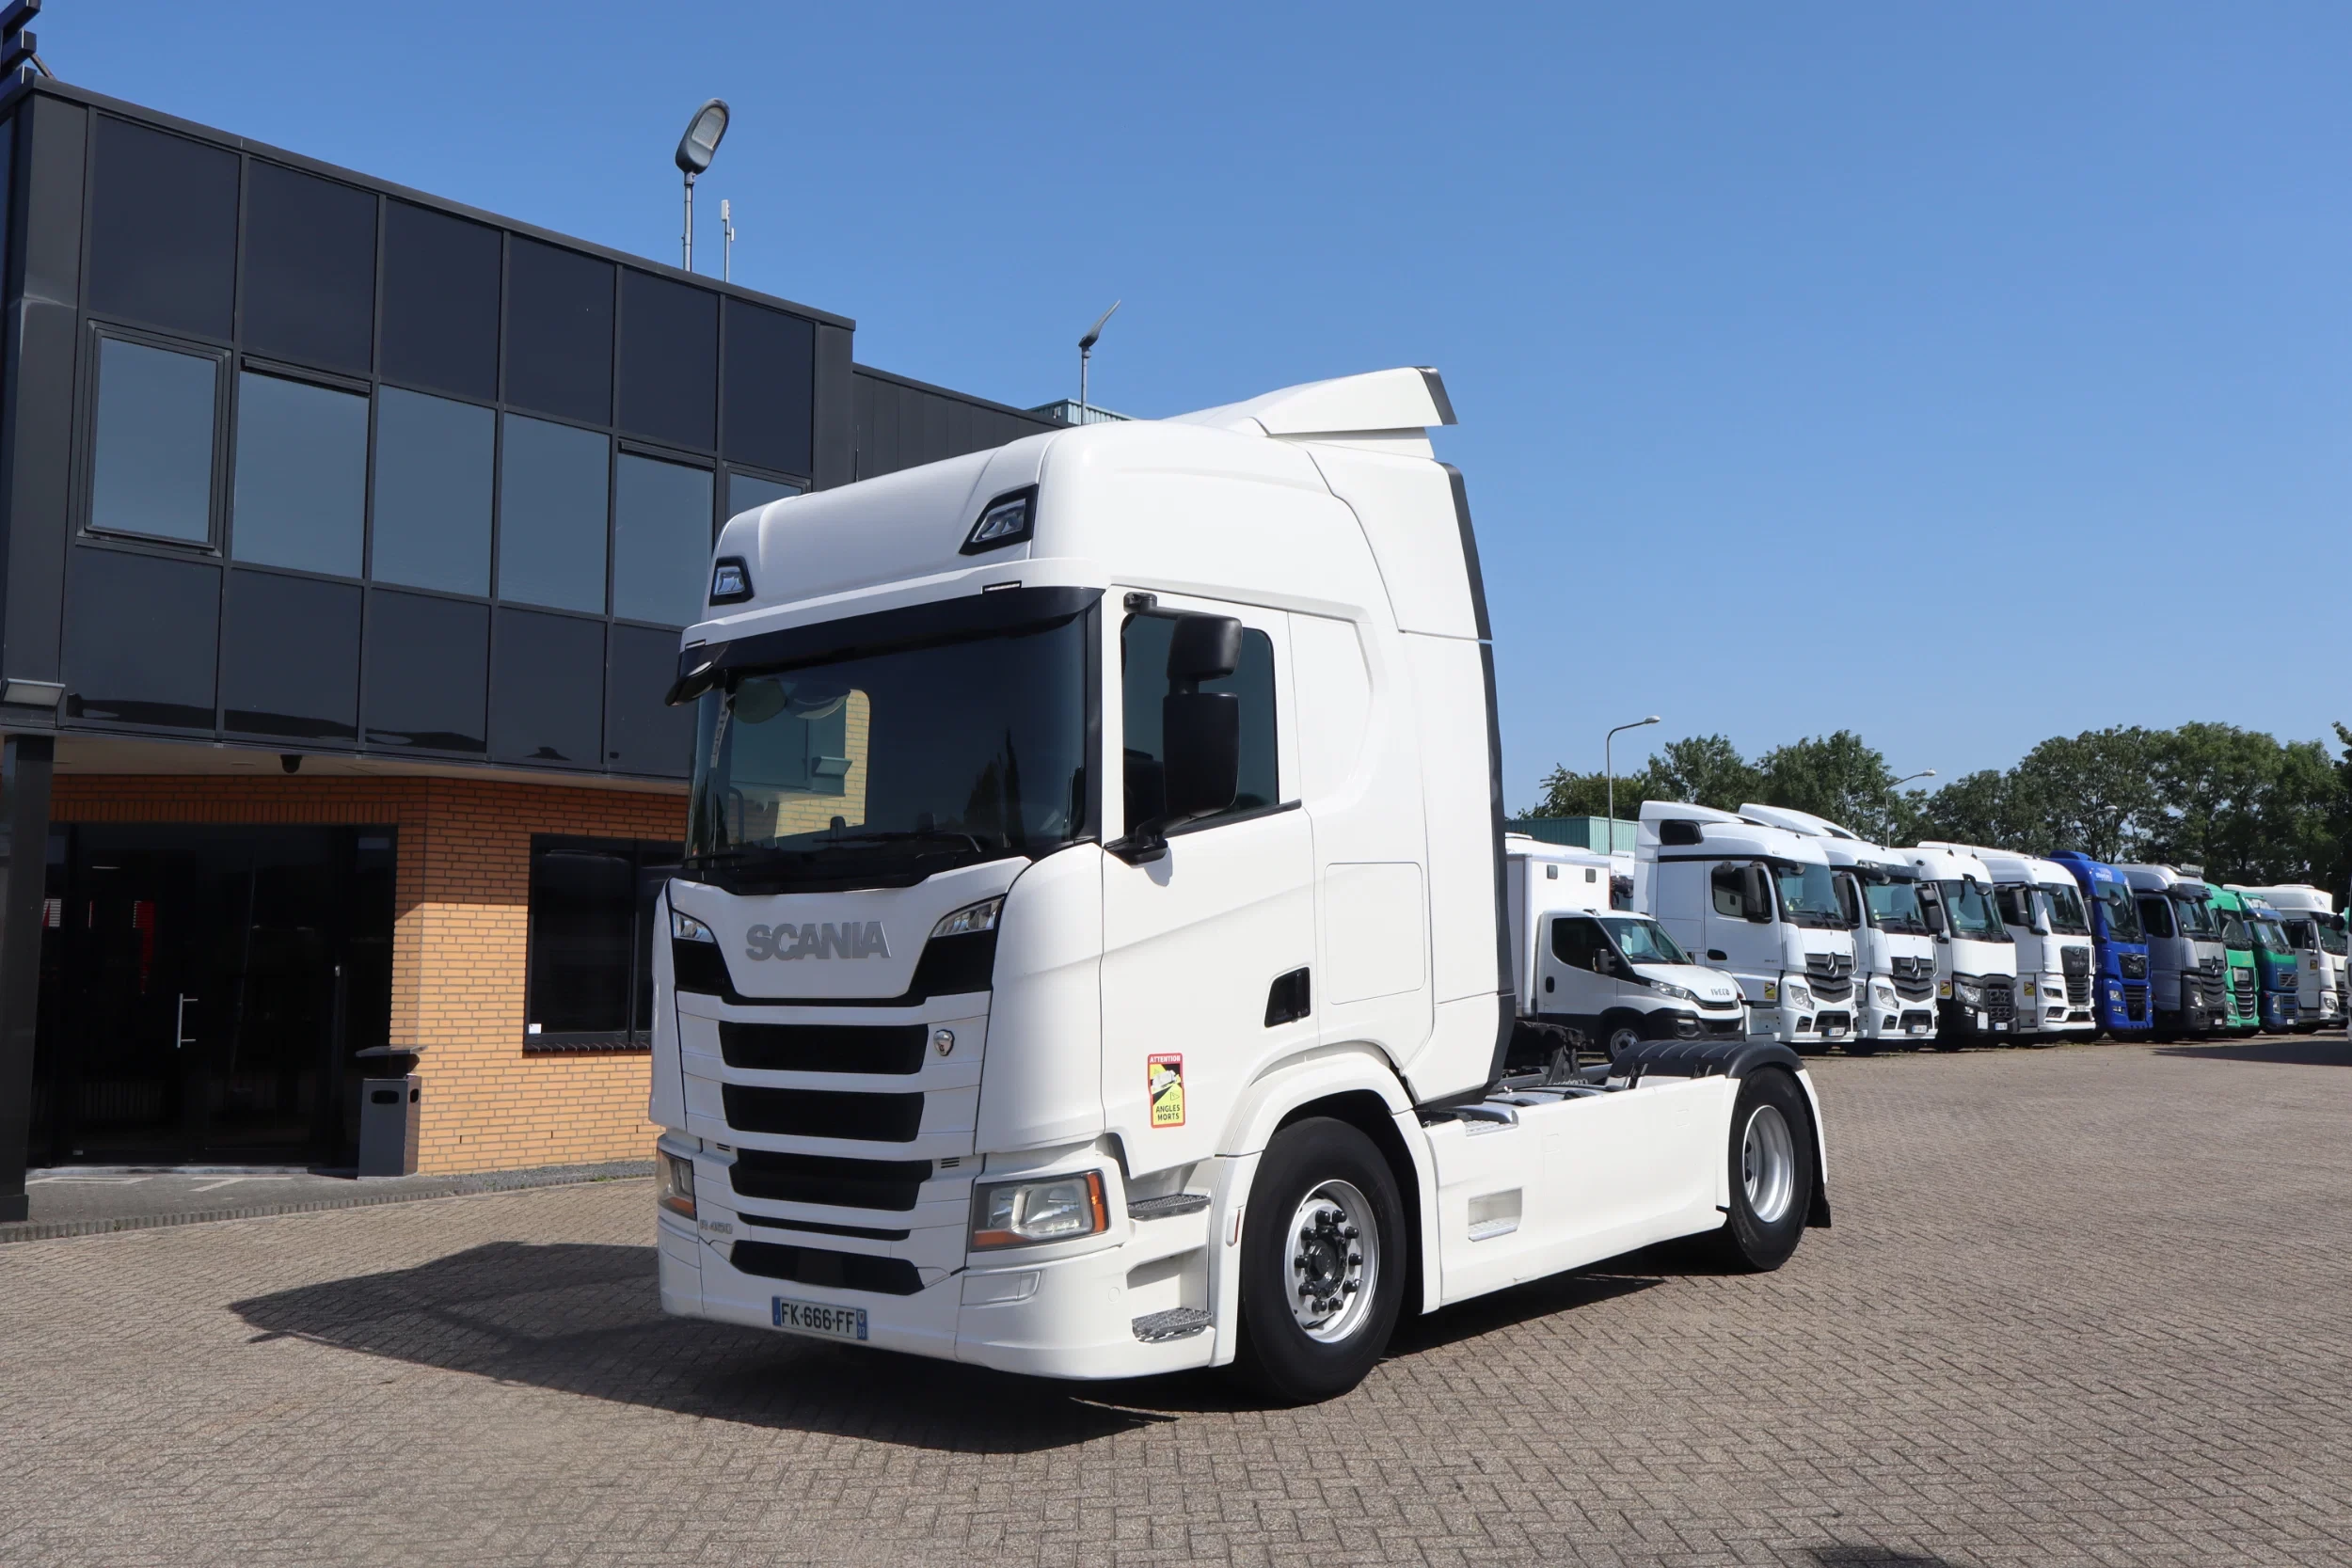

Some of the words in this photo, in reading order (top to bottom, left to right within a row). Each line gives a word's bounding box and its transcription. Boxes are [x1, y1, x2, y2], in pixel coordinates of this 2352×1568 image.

[745, 921, 892, 961] SCANIA
[1710, 988, 1730, 996] IVECO
[1155, 1104, 1181, 1113] ANGLES
[1157, 1113, 1180, 1121] MORTS
[857, 1326, 866, 1338] 33
